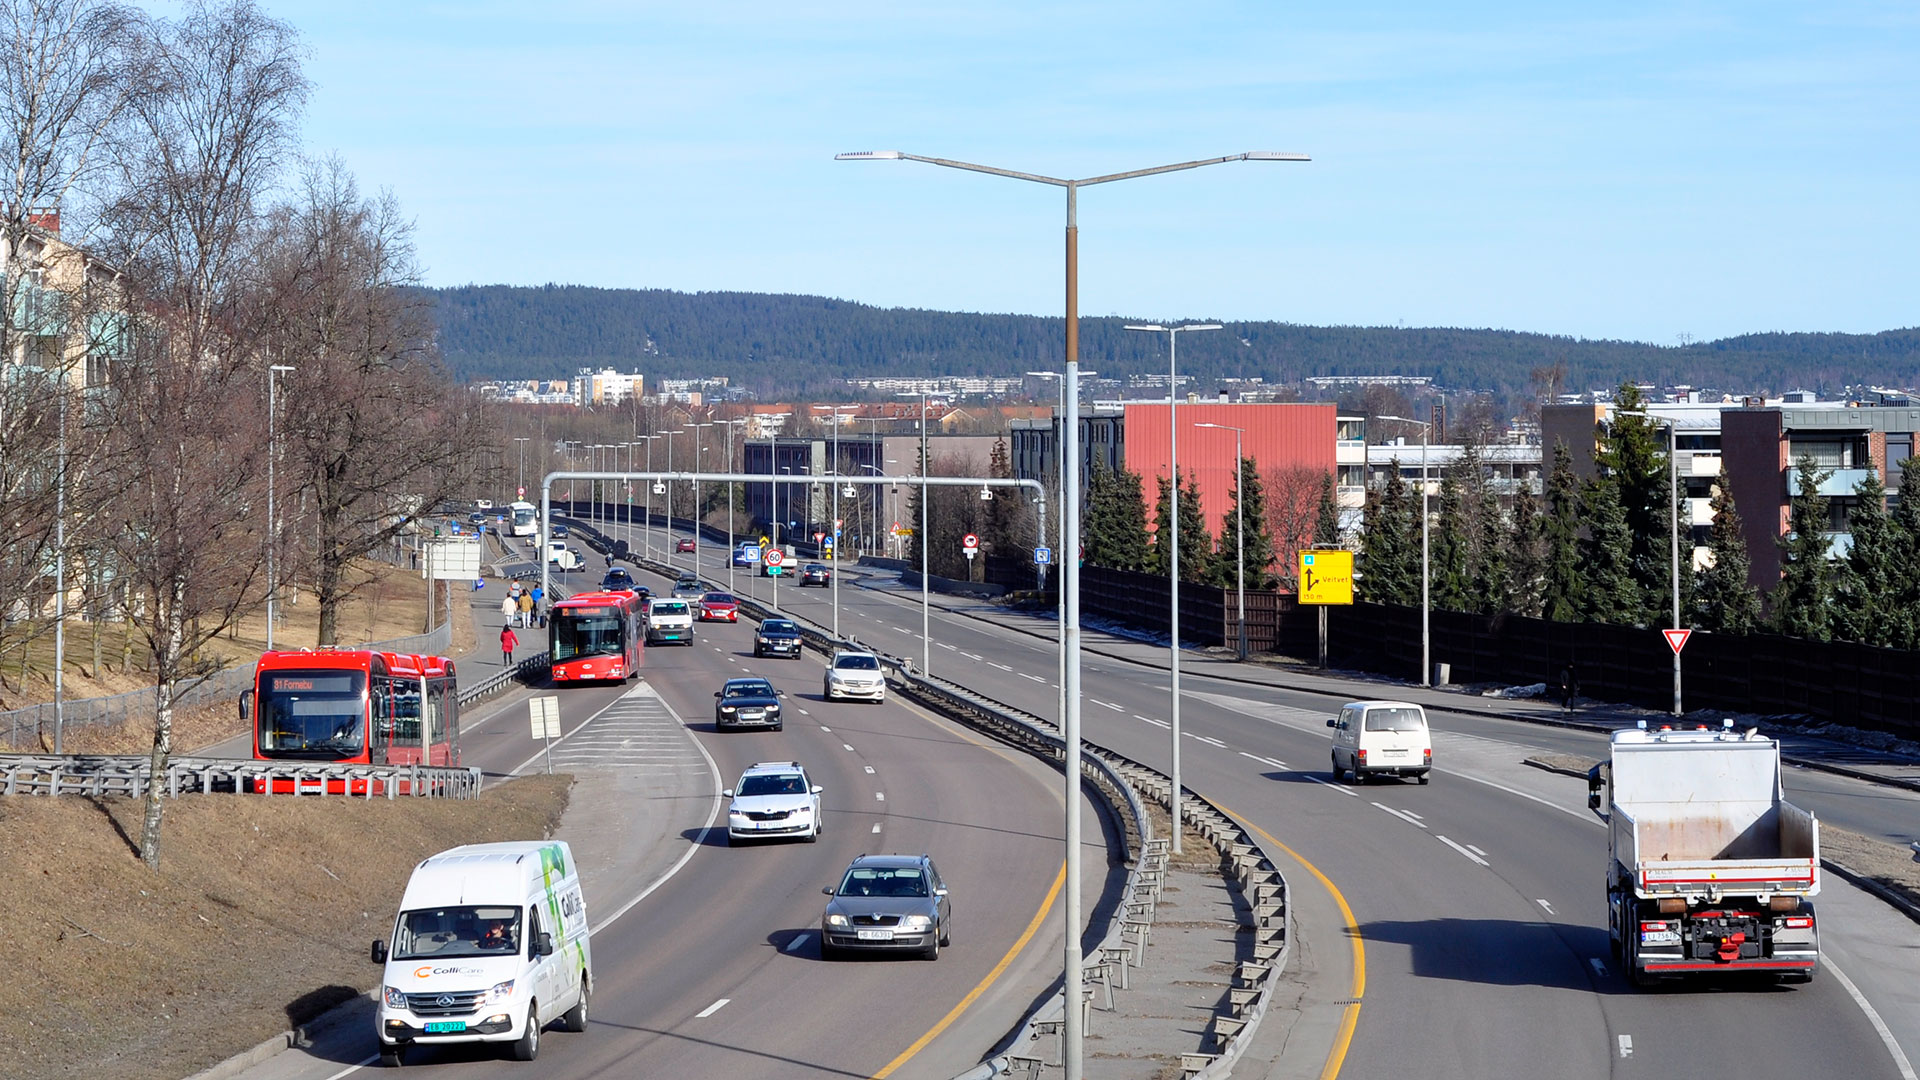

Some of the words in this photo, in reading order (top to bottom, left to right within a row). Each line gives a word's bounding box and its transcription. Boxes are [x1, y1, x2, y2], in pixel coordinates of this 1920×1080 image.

[769, 553, 781, 562] 60
[274, 680, 282, 690] 31
[283, 680, 313, 690] Fornebu
[432, 967, 484, 975] ColliCare
